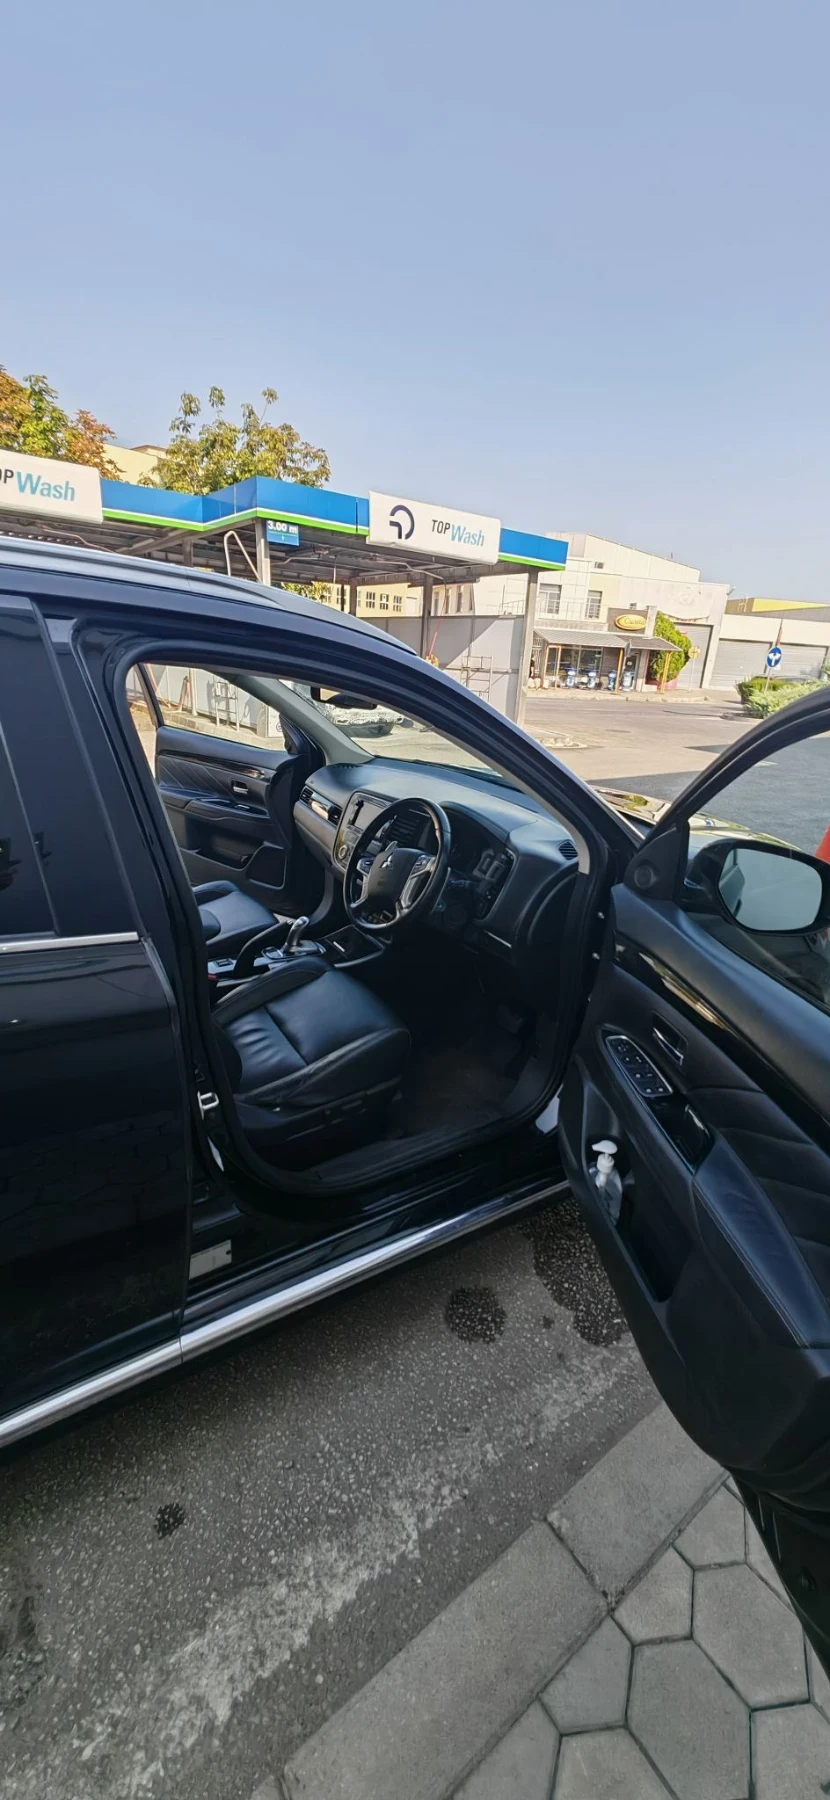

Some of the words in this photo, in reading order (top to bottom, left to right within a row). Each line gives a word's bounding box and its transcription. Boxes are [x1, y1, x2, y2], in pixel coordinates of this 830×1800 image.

[16, 471, 76, 502] Wash
[431, 519, 451, 535] TOP
[451, 524, 485, 547] Wash
